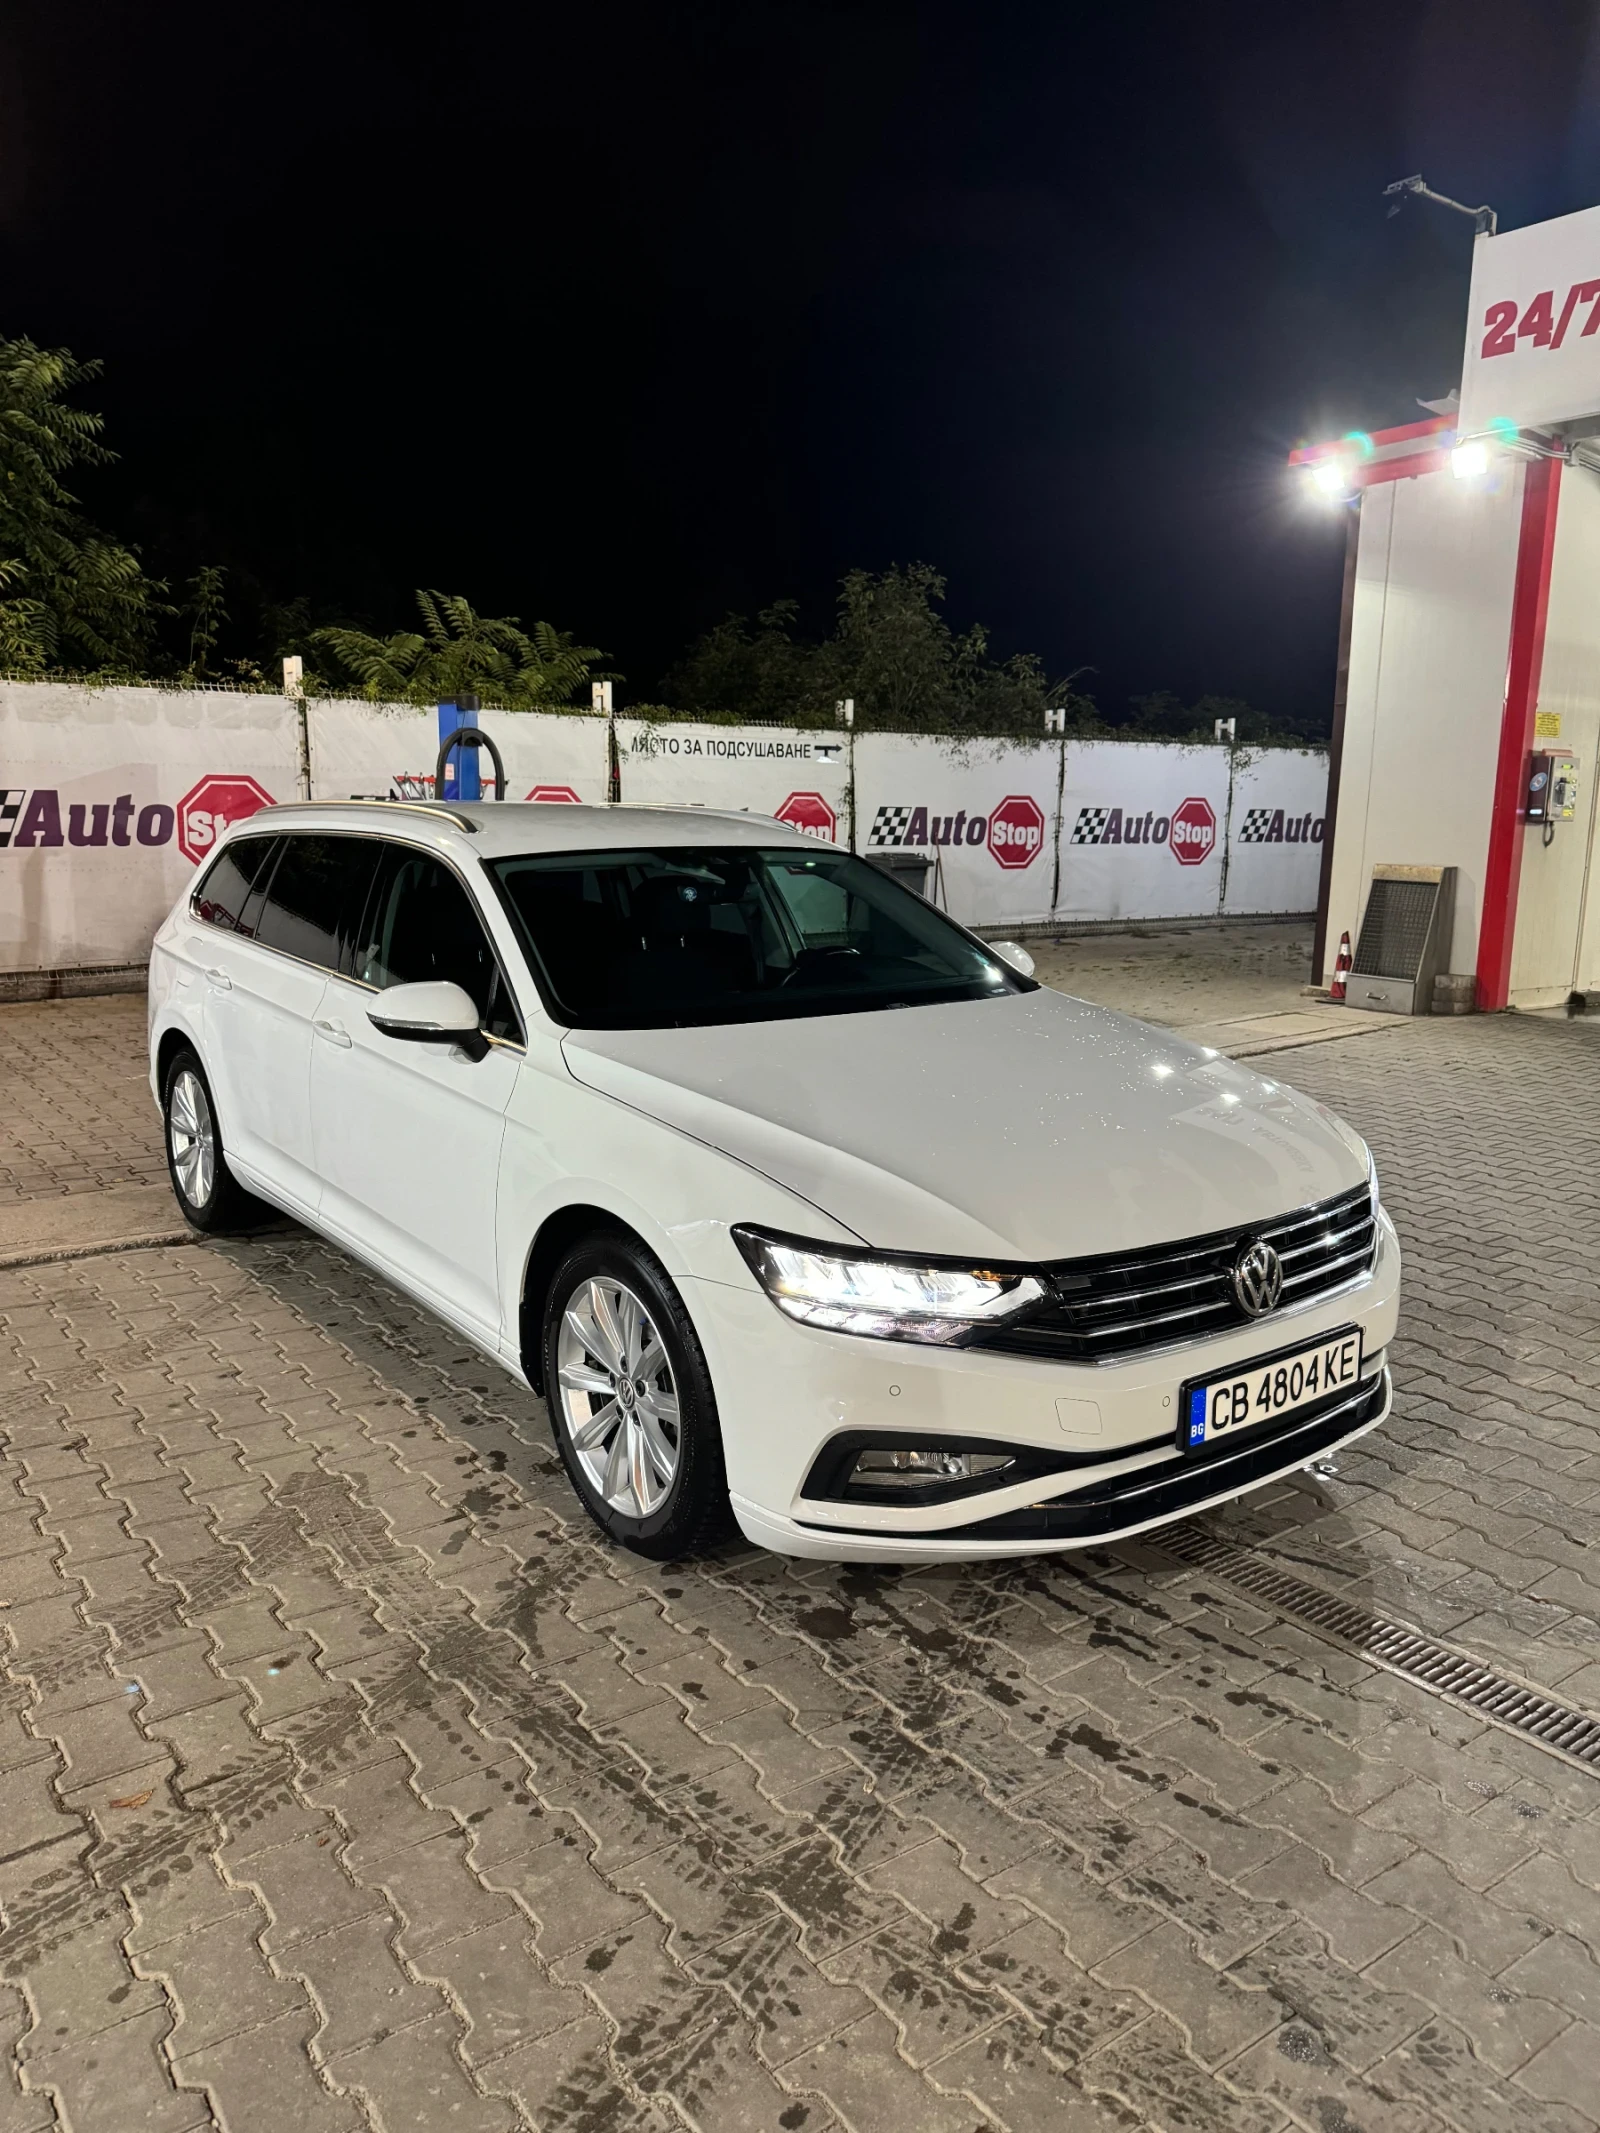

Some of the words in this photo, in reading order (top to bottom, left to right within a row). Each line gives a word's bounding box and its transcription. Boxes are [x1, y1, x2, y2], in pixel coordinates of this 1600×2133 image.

[1481, 279, 1600, 359] 24/7
[683, 739, 702, 755] ЗА
[707, 740, 811, 759] ПОДСУШАВАНЕ
[13, 790, 175, 847] Auto
[188, 810, 242, 846] St
[903, 807, 987, 846] Auto
[993, 820, 1039, 850] Stop
[1101, 808, 1170, 844] Auto
[1174, 820, 1212, 849] Stop
[1264, 809, 1326, 843] Auto
[1211, 1381, 1249, 1430] CB
[1256, 1354, 1319, 1413] 4804
[1324, 1340, 1355, 1389] KE
[1191, 1423, 1204, 1438] BG
